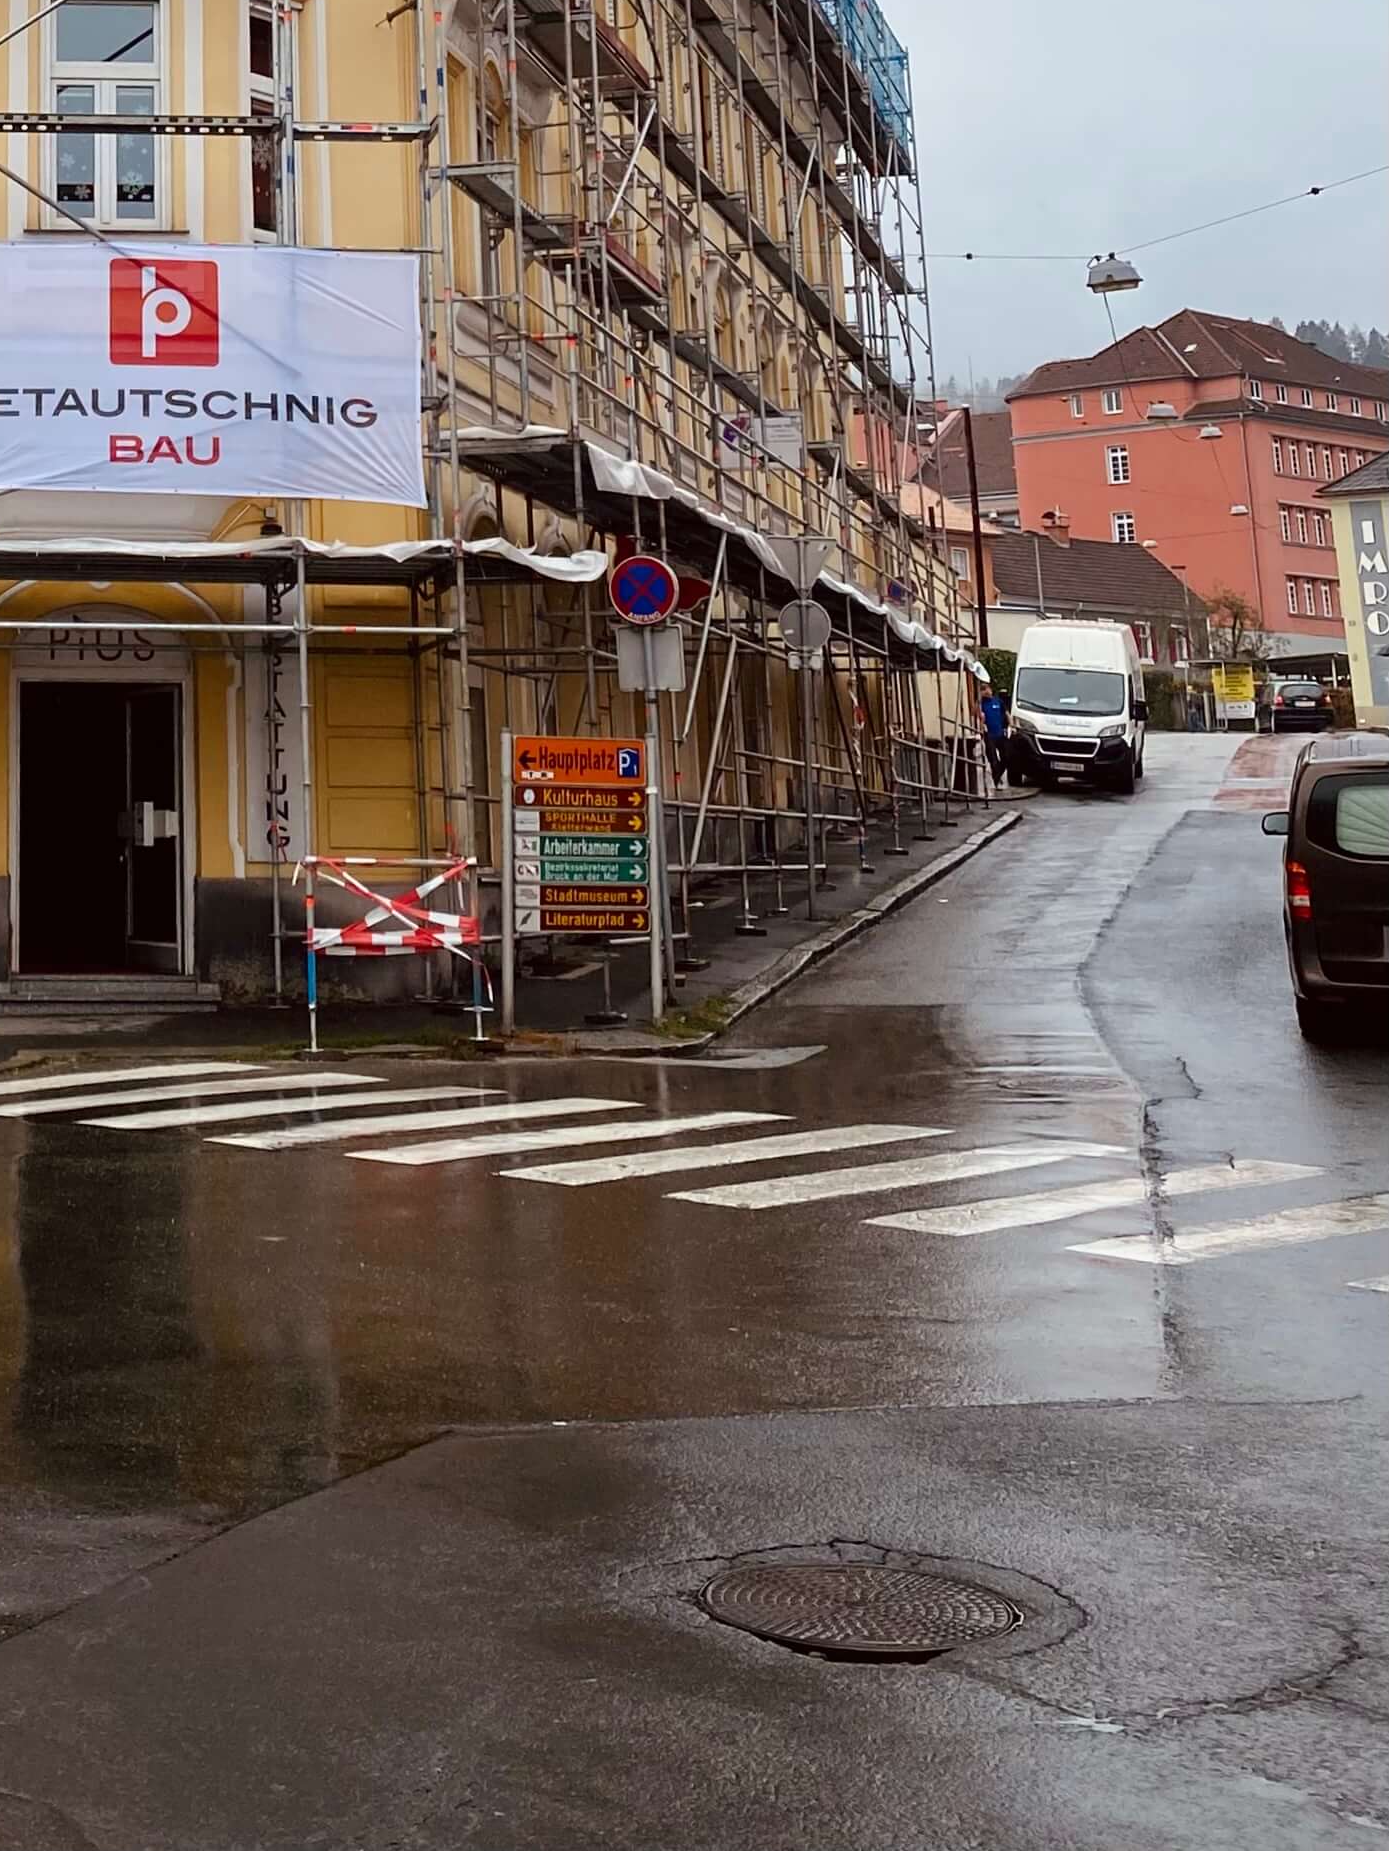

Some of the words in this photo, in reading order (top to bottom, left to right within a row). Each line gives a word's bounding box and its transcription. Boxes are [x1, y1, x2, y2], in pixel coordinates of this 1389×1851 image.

[109, 435, 221, 466] BAU
[539, 746, 616, 777] Hauptplatz
[543, 787, 619, 807] Kulturhaus
[544, 811, 618, 824] SPORTHALLE
[543, 837, 621, 856] Arbeiterkammer
[544, 888, 629, 903] Stadtmuseum
[545, 911, 626, 930] Literaturpfad
